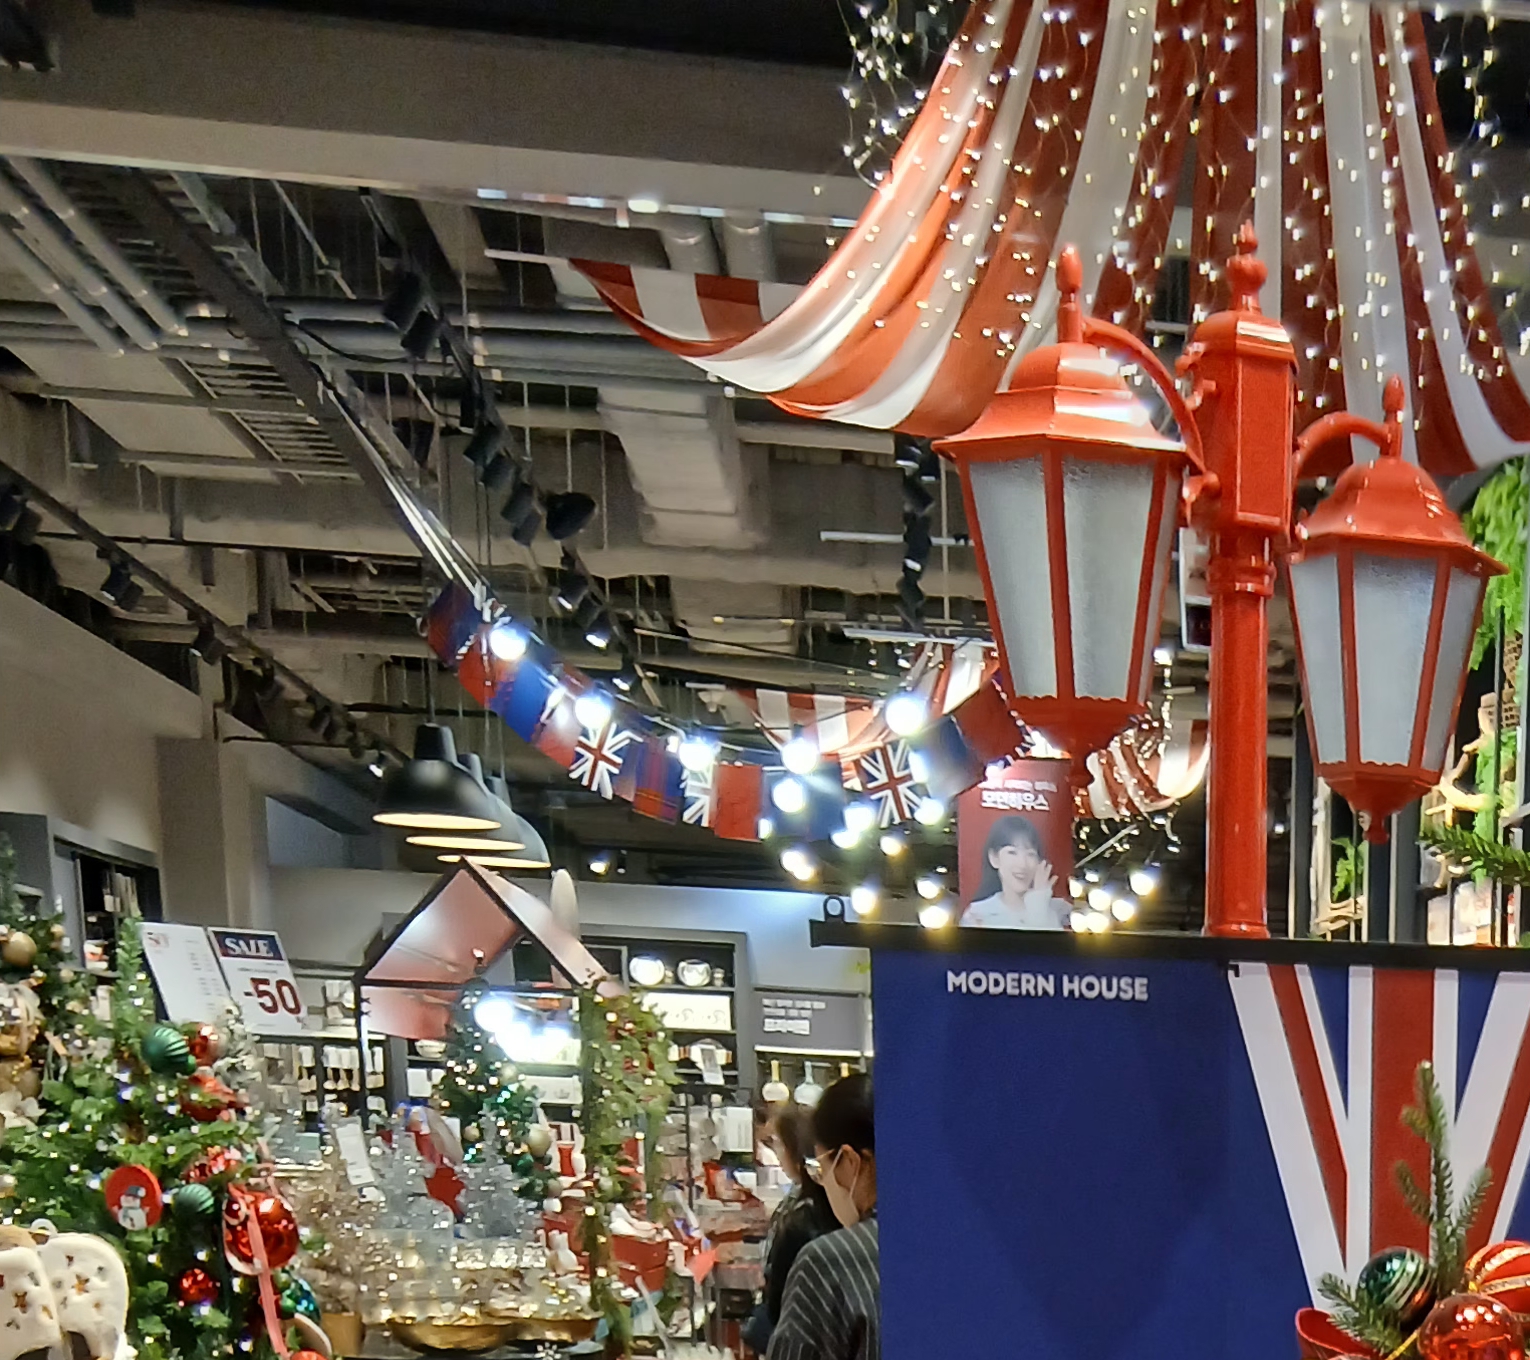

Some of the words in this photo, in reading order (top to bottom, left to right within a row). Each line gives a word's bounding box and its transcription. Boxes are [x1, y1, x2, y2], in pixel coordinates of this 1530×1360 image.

[224, 937, 274, 957] SALE
[243, 977, 302, 1015] -50
[947, 970, 1055, 997] MODERN
[1062, 974, 1149, 1001] HOUSE
